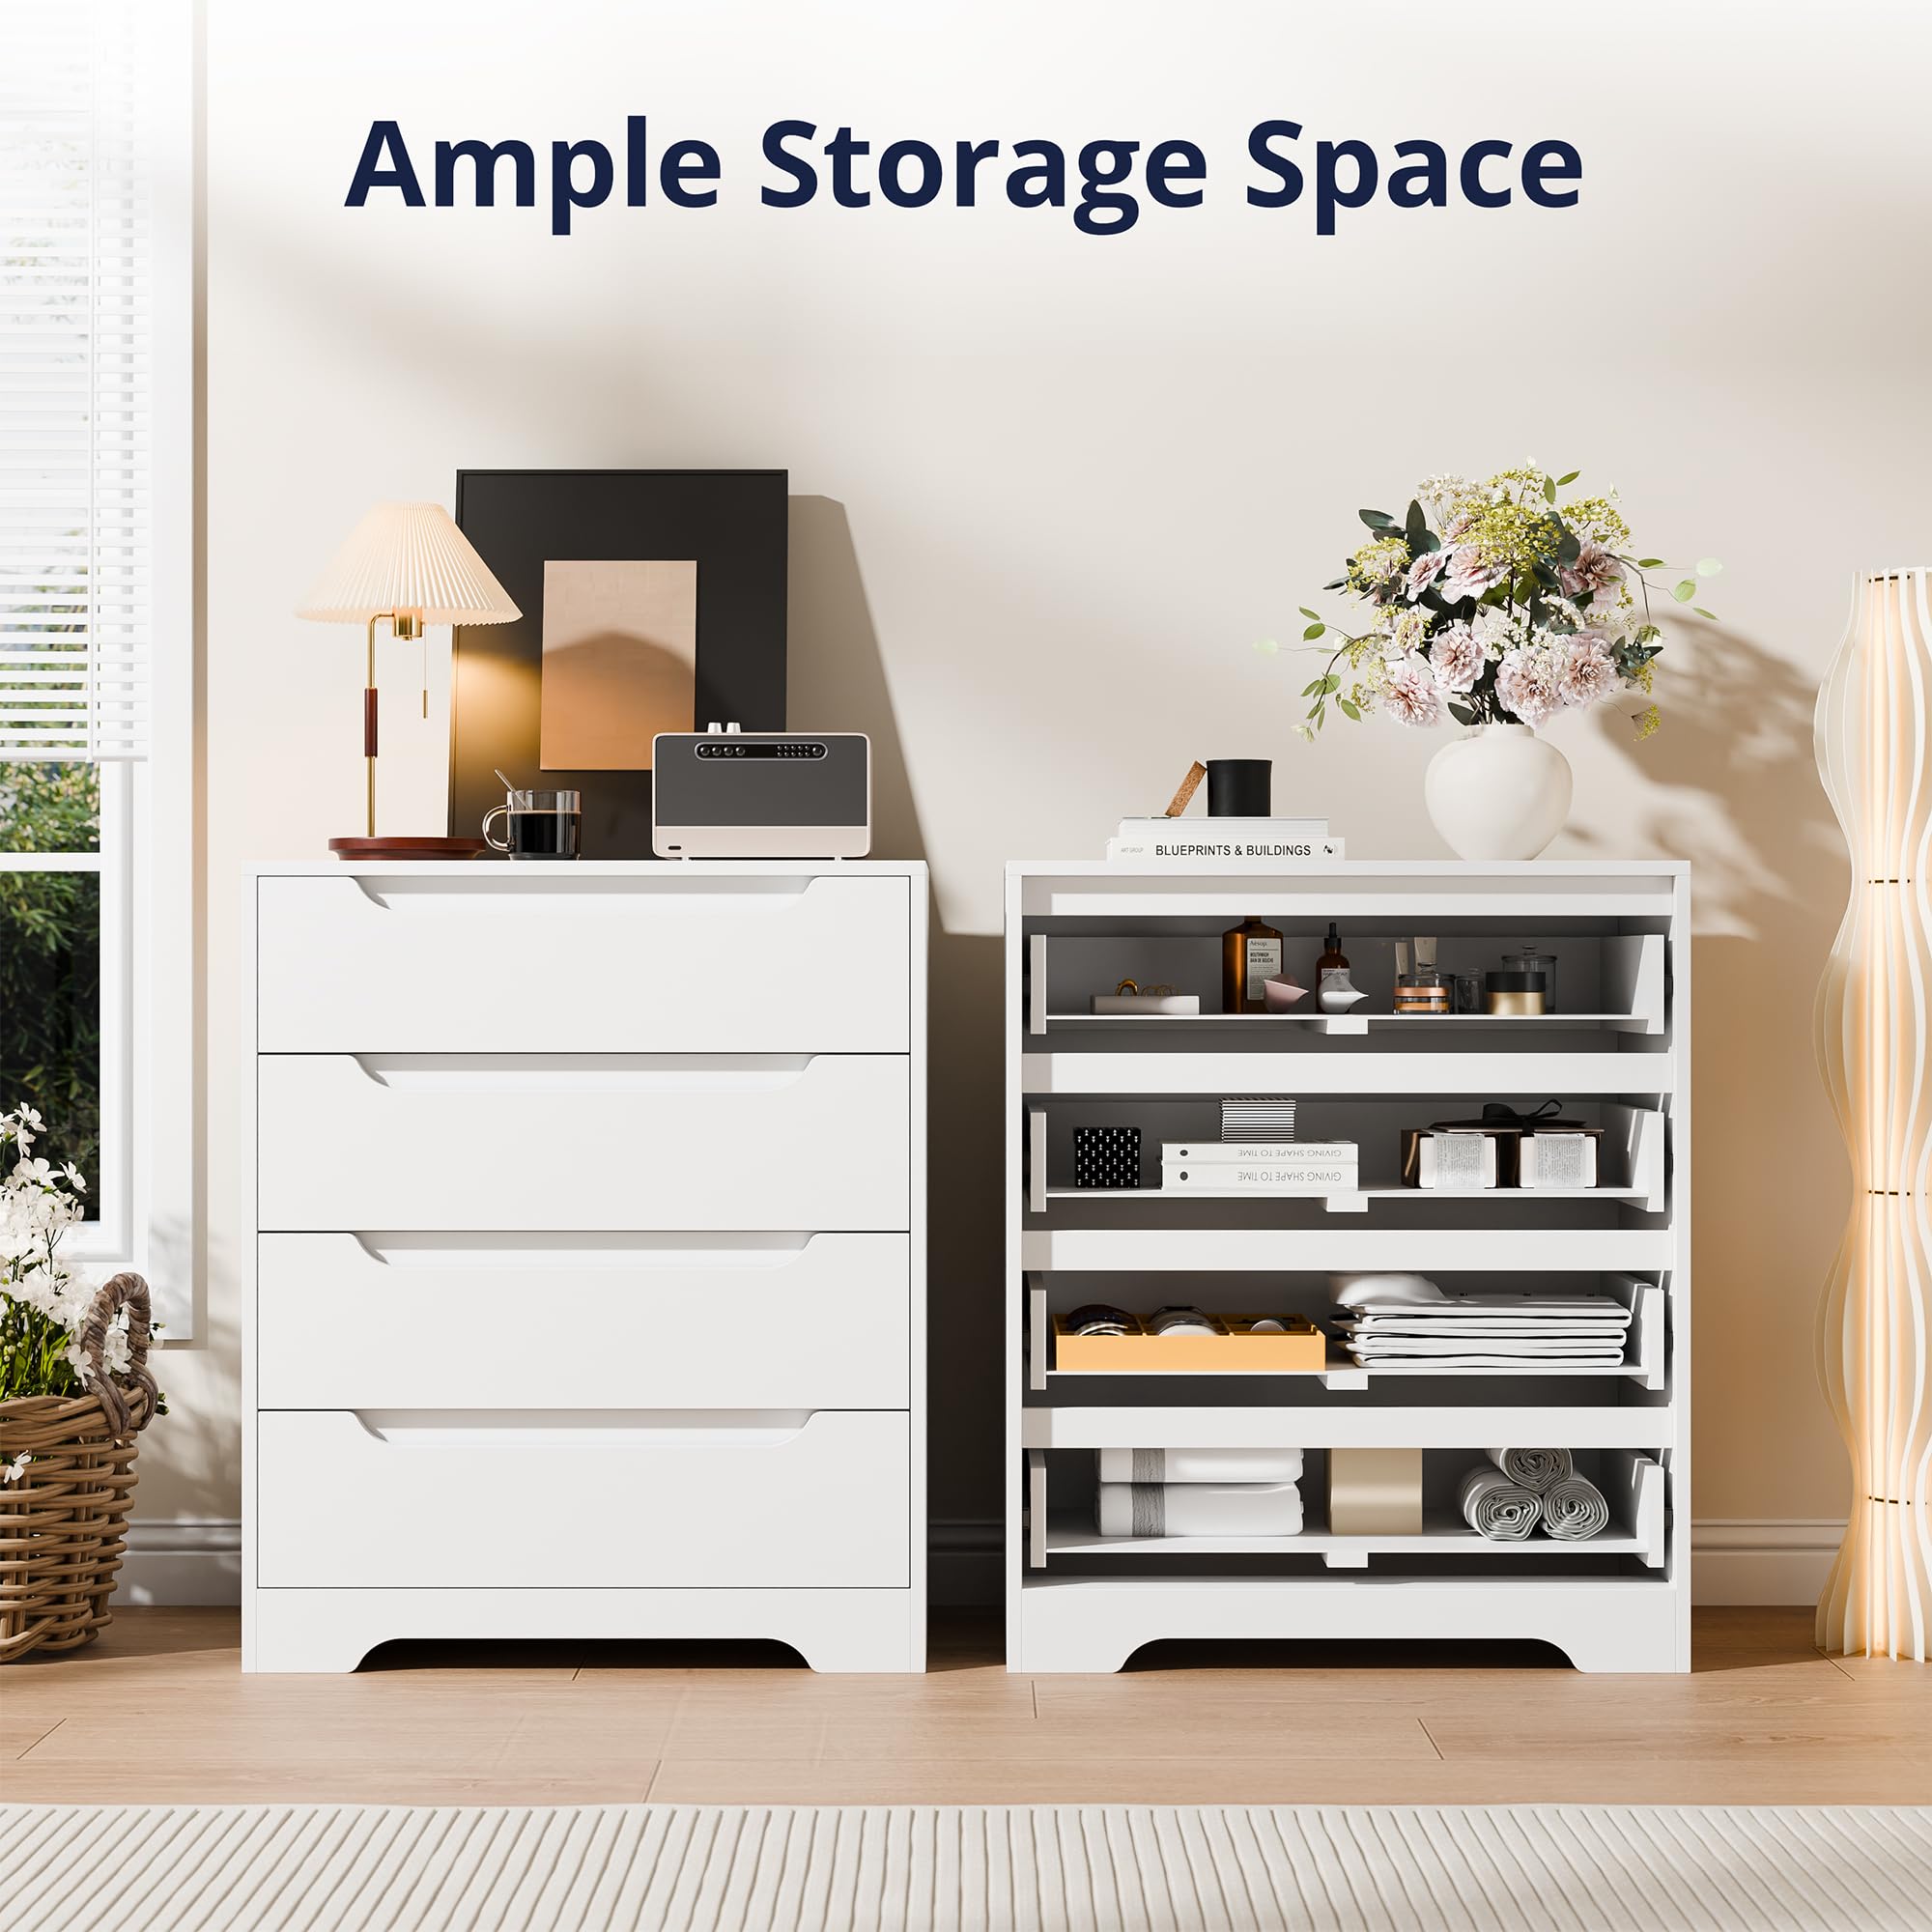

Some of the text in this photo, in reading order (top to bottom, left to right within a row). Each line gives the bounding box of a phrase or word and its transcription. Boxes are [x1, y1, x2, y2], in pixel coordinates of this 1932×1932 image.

[1155, 844, 1312, 857] BLUEPRINTS & BUILDINGS
[1237, 1149, 1342, 1157] GIVING SHAPE TO TIME
[1237, 1171, 1342, 1181] GIVING SHAPE TO TIME
